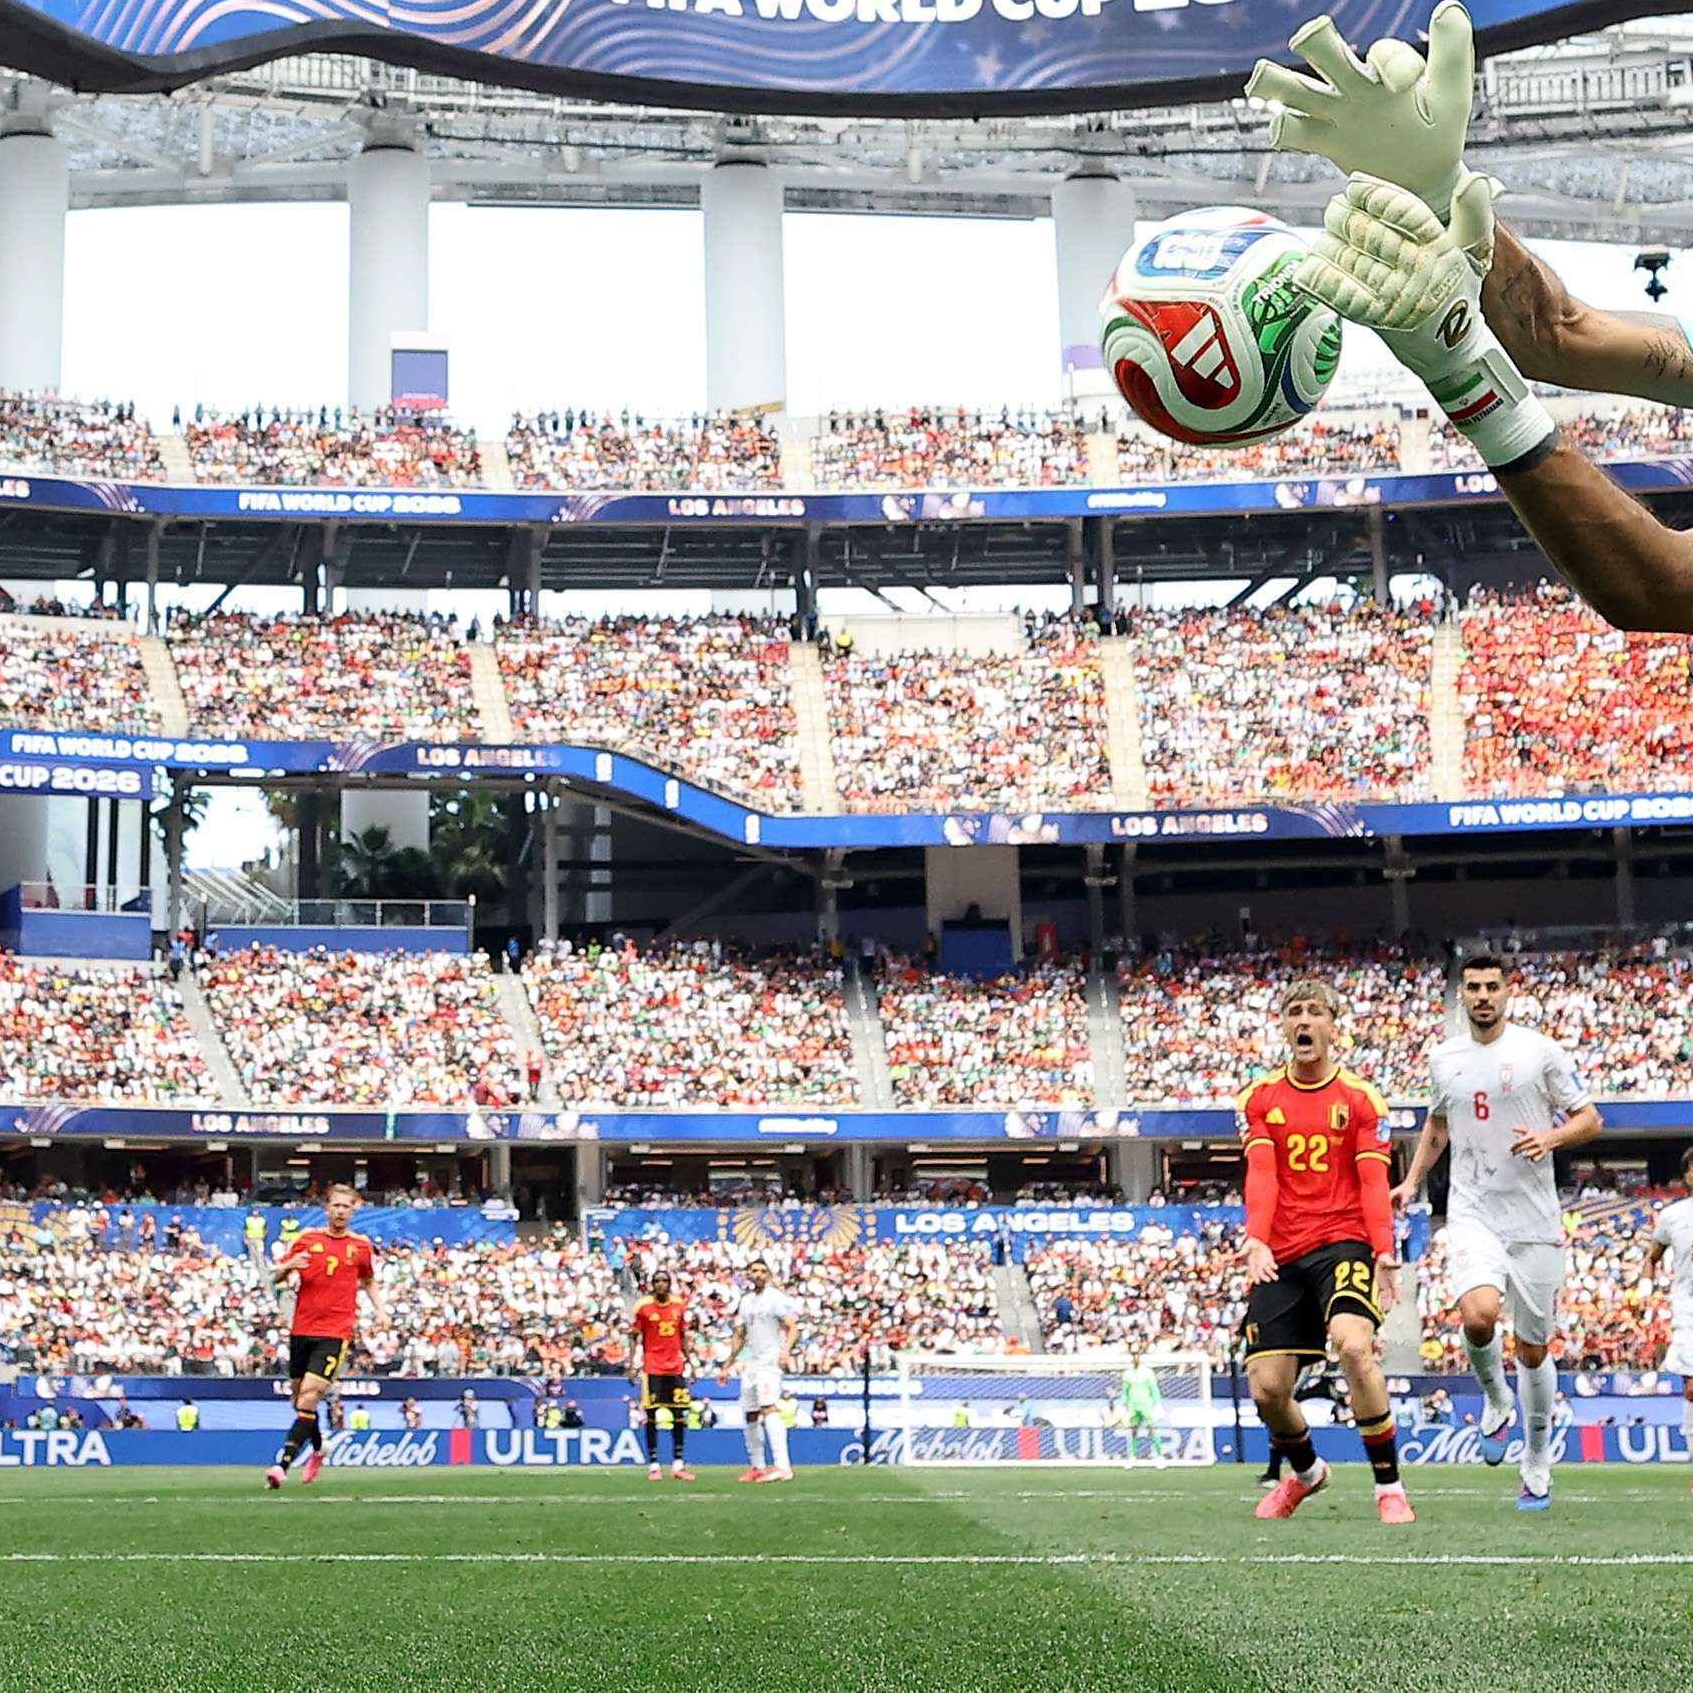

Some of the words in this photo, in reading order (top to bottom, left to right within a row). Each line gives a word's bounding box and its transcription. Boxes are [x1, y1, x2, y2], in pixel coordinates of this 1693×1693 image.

[238, 493, 281, 512] FIFA
[12, 734, 57, 754] FIFA
[58, 736, 129, 759] WORLD
[133, 741, 174, 762] CUP
[417, 748, 460, 767] LOS
[50, 767, 142, 793] 2026
[1449, 805, 1499, 827] FIFA
[1502, 801, 1581, 826] WORLD
[1584, 799, 1629, 823] CUP
[1111, 816, 1157, 836] LOS
[1473, 1090, 1490, 1121] 6
[192, 1114, 232, 1132] LOS
[1287, 1134, 1329, 1172] 22
[896, 1213, 966, 1233] LOS
[972, 1212, 1136, 1233] ANGELES
[325, 1255, 340, 1276] 7
[1334, 1260, 1371, 1292] 22
[324, 1355, 337, 1377] 7
[486, 1428, 645, 1465] ULTRA
